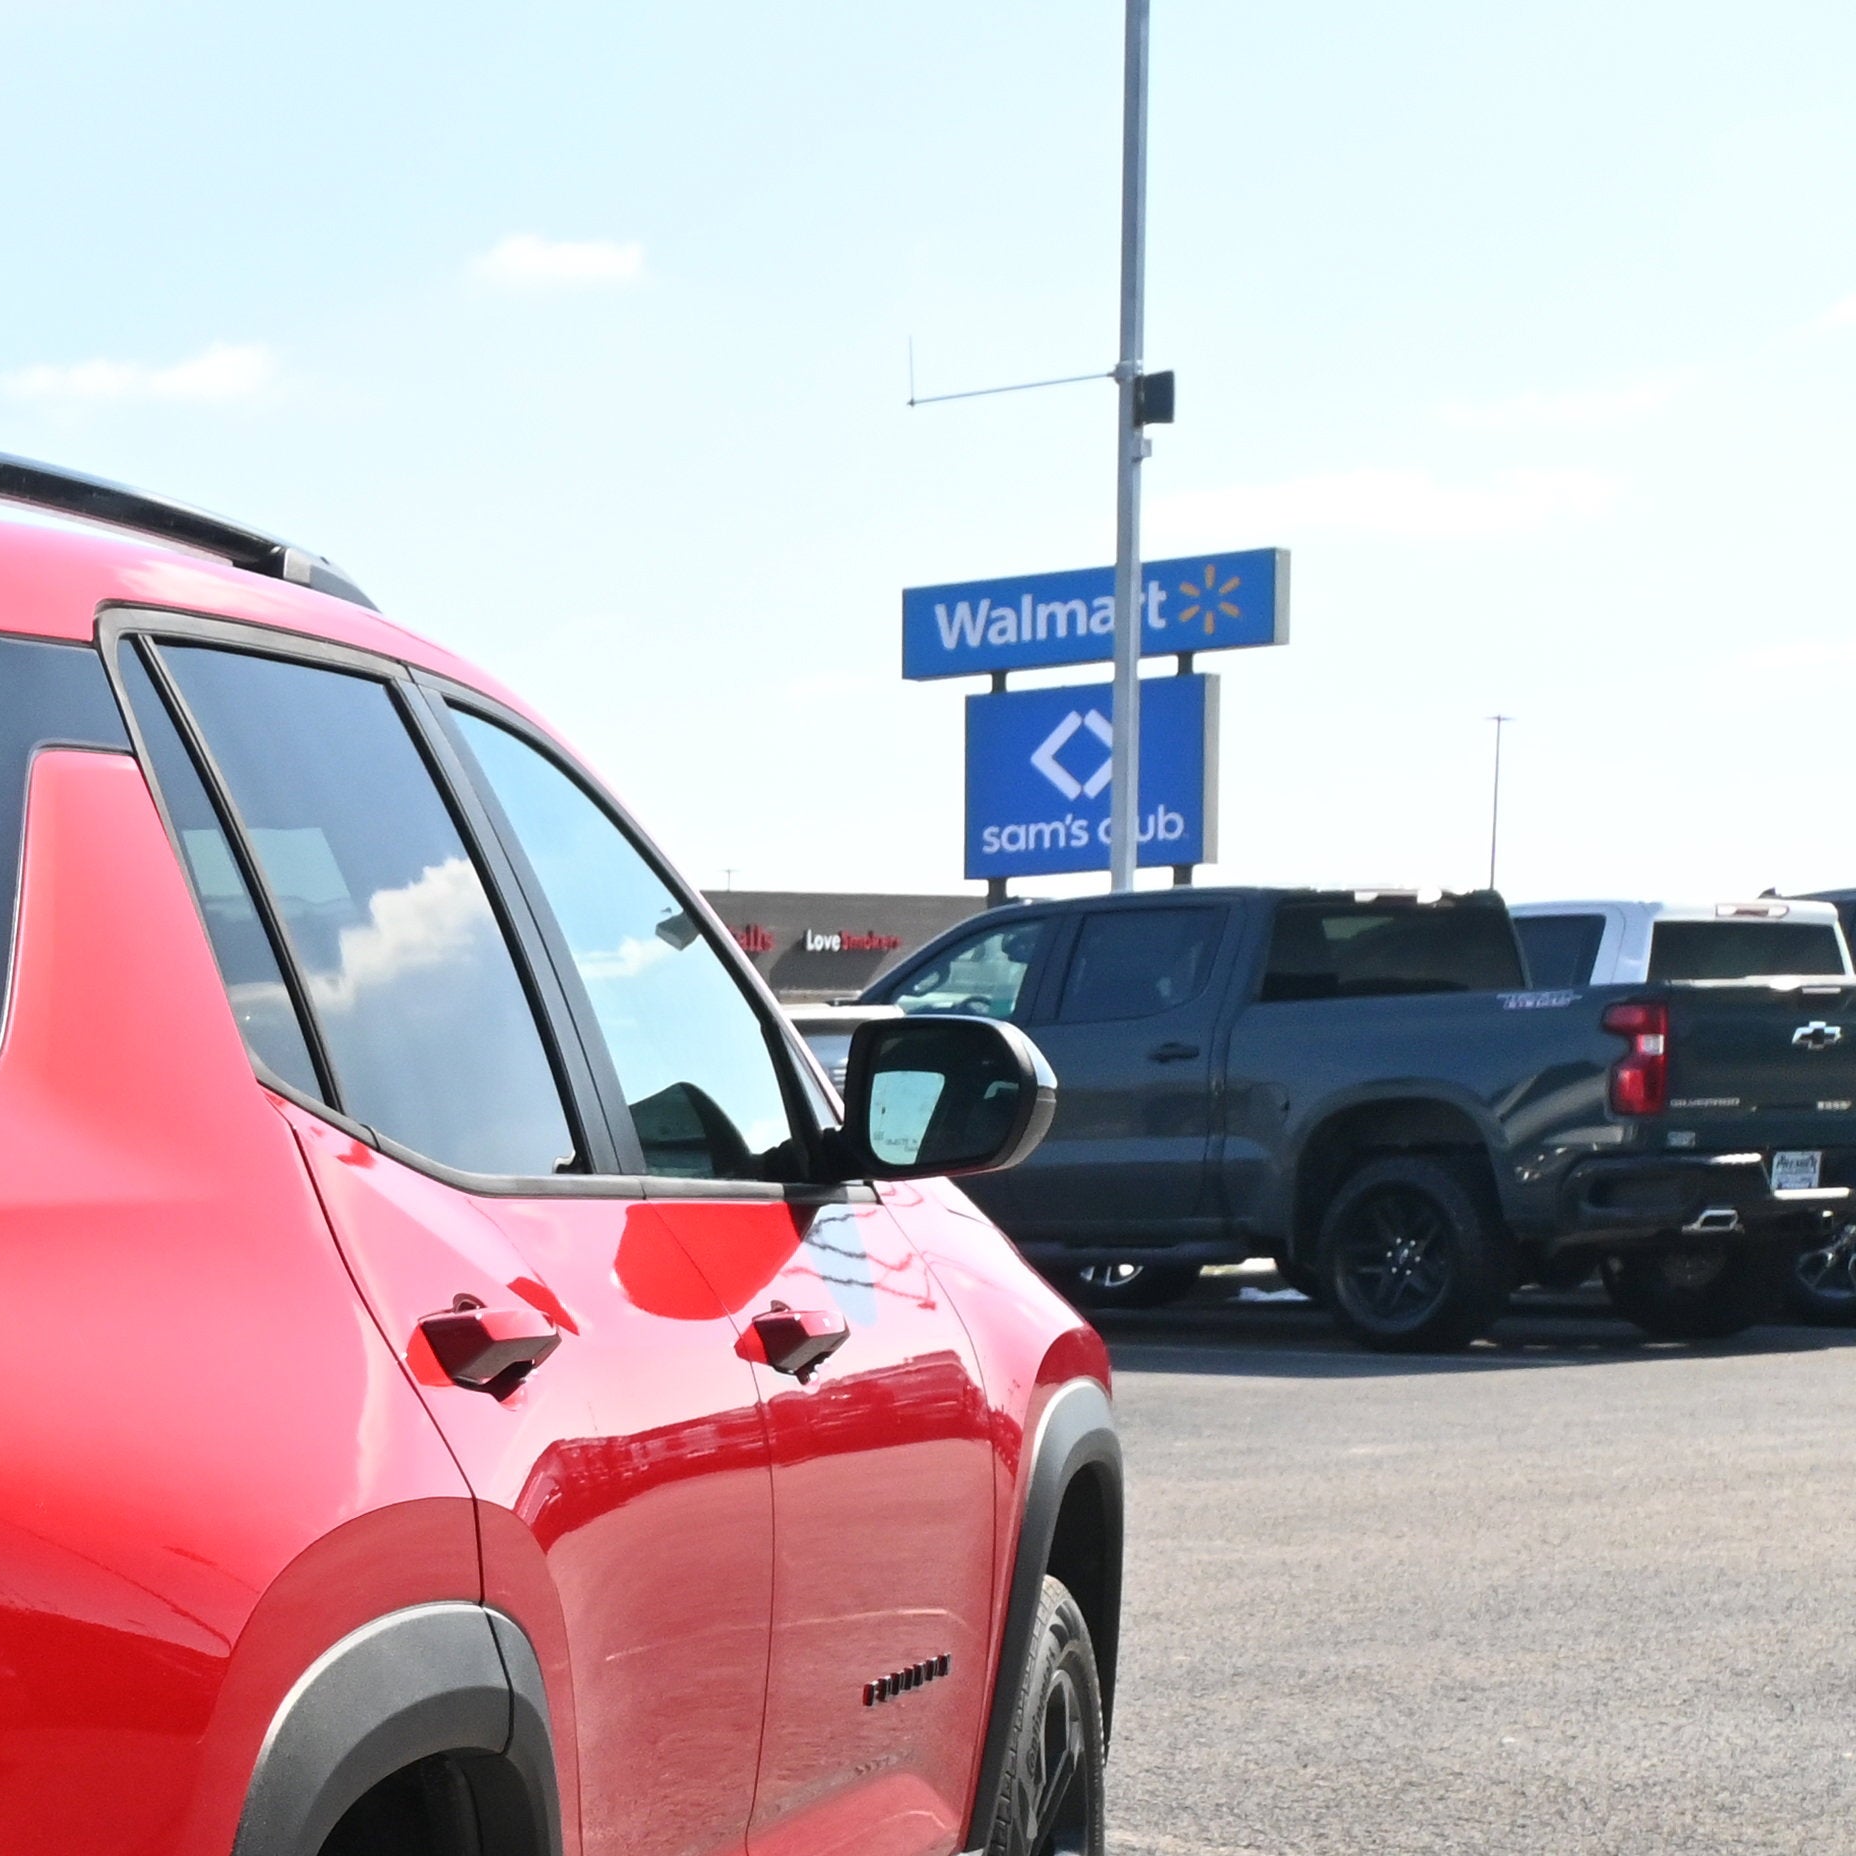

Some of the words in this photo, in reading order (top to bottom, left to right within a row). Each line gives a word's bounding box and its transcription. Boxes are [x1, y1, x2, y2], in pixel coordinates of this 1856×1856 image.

[934, 581, 1168, 650] Walmat
[982, 812, 1089, 854] sam's
[1098, 804, 1186, 846] cub
